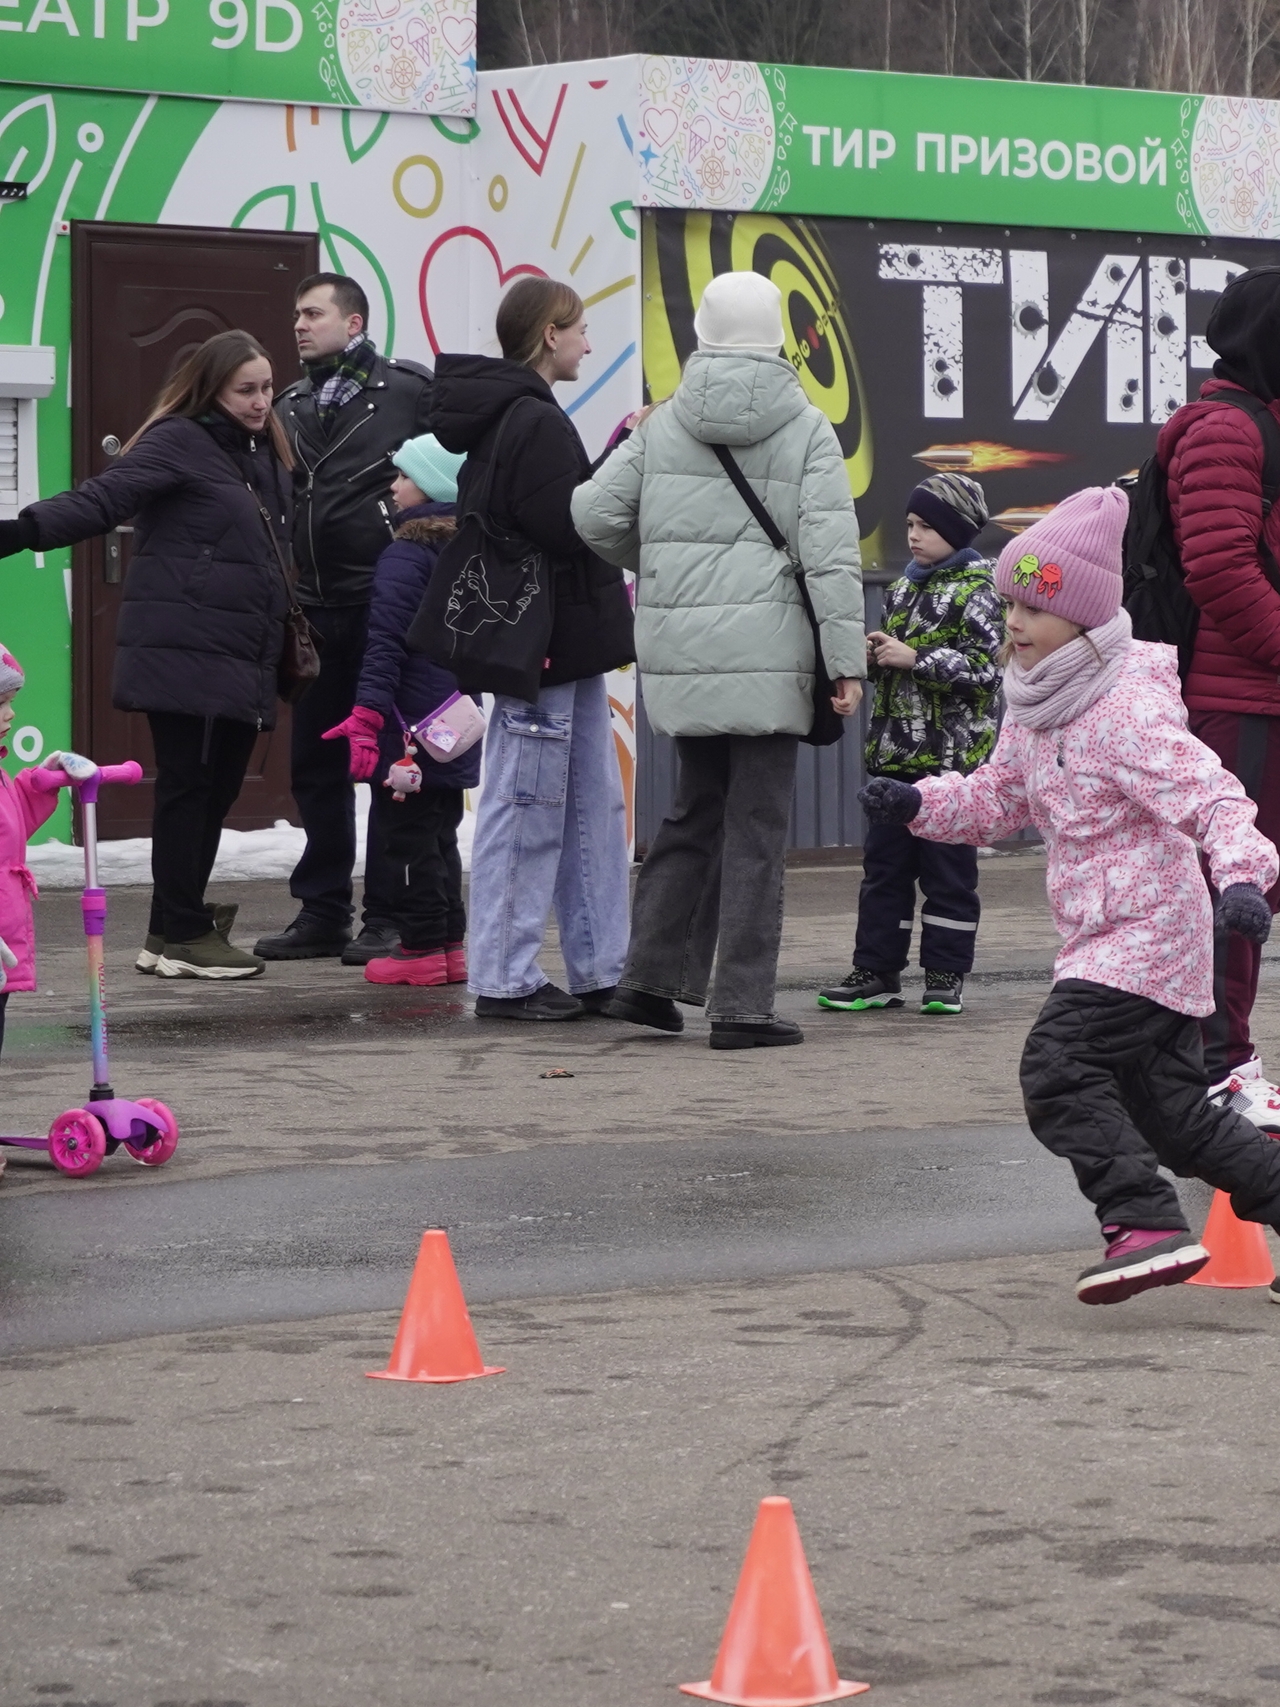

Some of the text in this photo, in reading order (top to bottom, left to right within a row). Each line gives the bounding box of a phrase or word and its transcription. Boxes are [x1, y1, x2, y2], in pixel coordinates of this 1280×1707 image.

[209, 0, 304, 53] 9D
[802, 125, 1167, 186] ТИР ПРИЗОВОЙ
